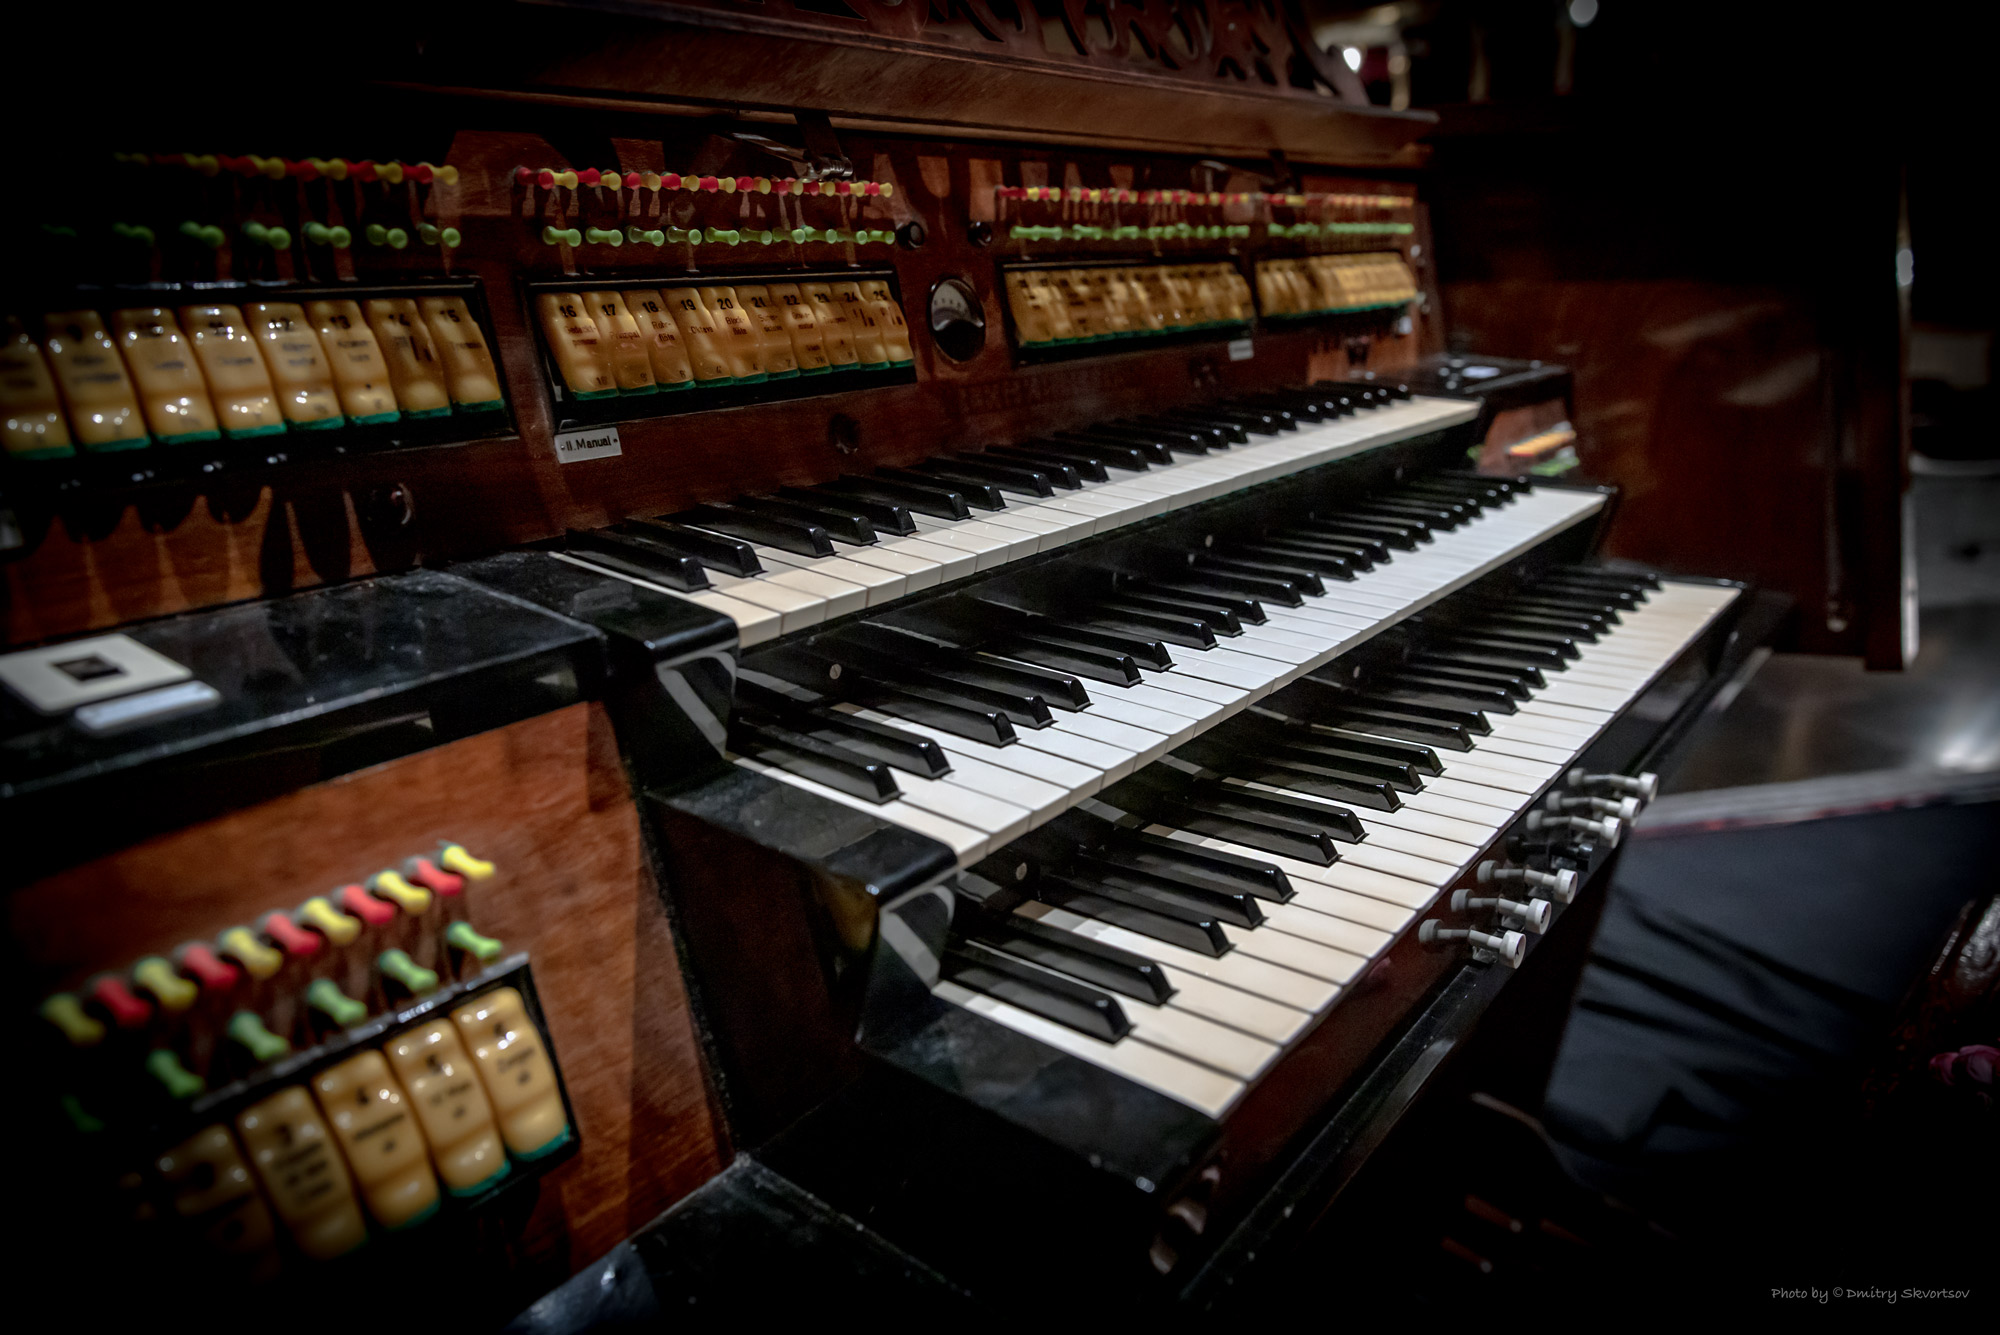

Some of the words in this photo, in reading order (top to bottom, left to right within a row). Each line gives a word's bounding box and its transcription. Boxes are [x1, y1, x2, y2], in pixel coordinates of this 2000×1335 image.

[751, 296, 767, 308] 21
[783, 294, 801, 306] 22
[844, 291, 859, 303] 24
[601, 303, 616, 317] 17
[642, 301, 659, 313] 18
[681, 298, 697, 311] 19
[717, 298, 734, 310] 20
[560, 305, 577, 318] 16
